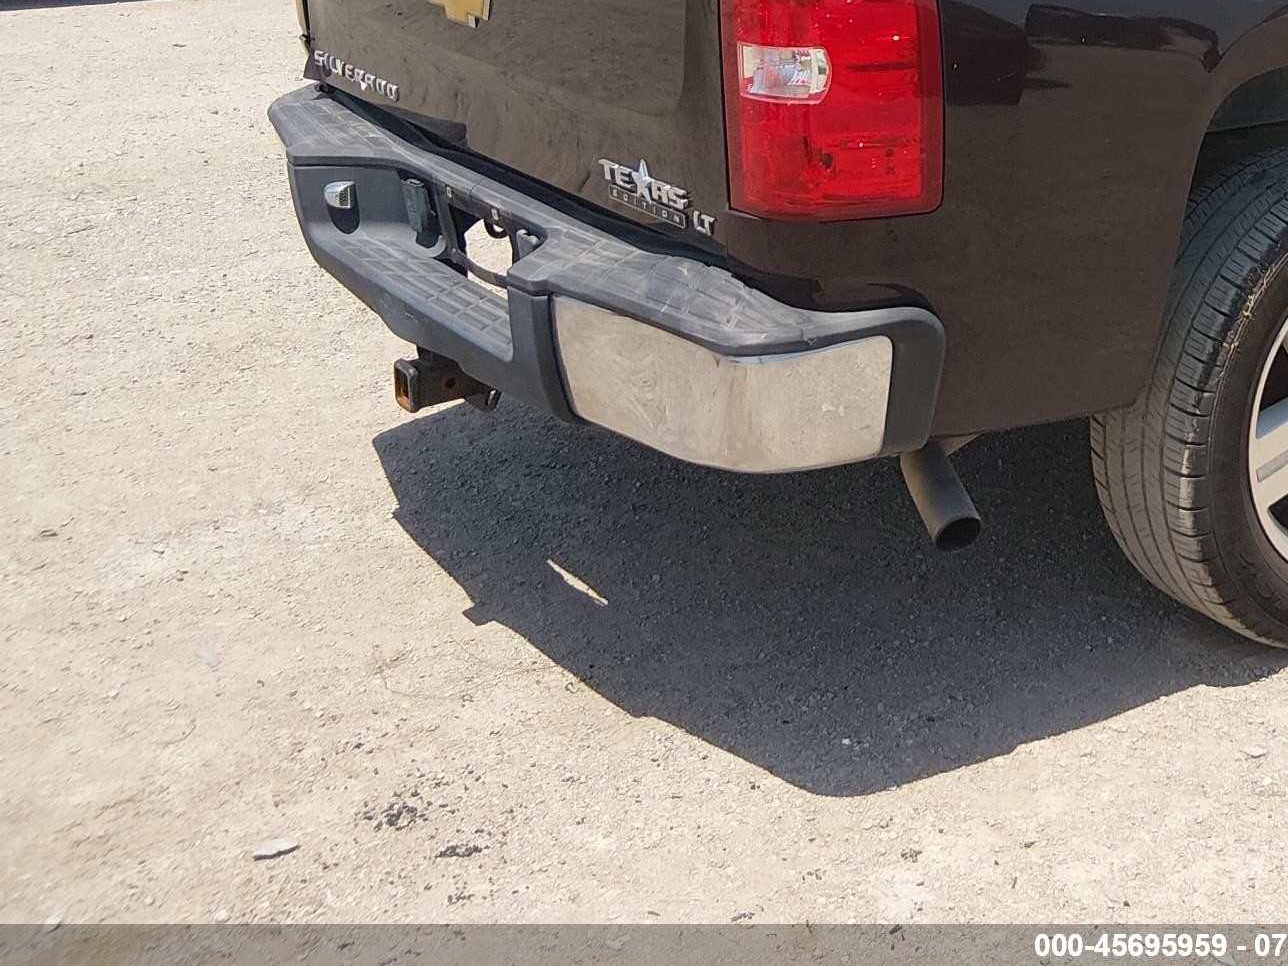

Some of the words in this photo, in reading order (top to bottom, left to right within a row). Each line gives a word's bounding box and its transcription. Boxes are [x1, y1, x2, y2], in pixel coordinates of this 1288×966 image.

[314, 49, 400, 102] SILVERADO
[598, 158, 689, 211] TEXAS
[611, 188, 682, 224] EDITION
[692, 210, 716, 237] LT
